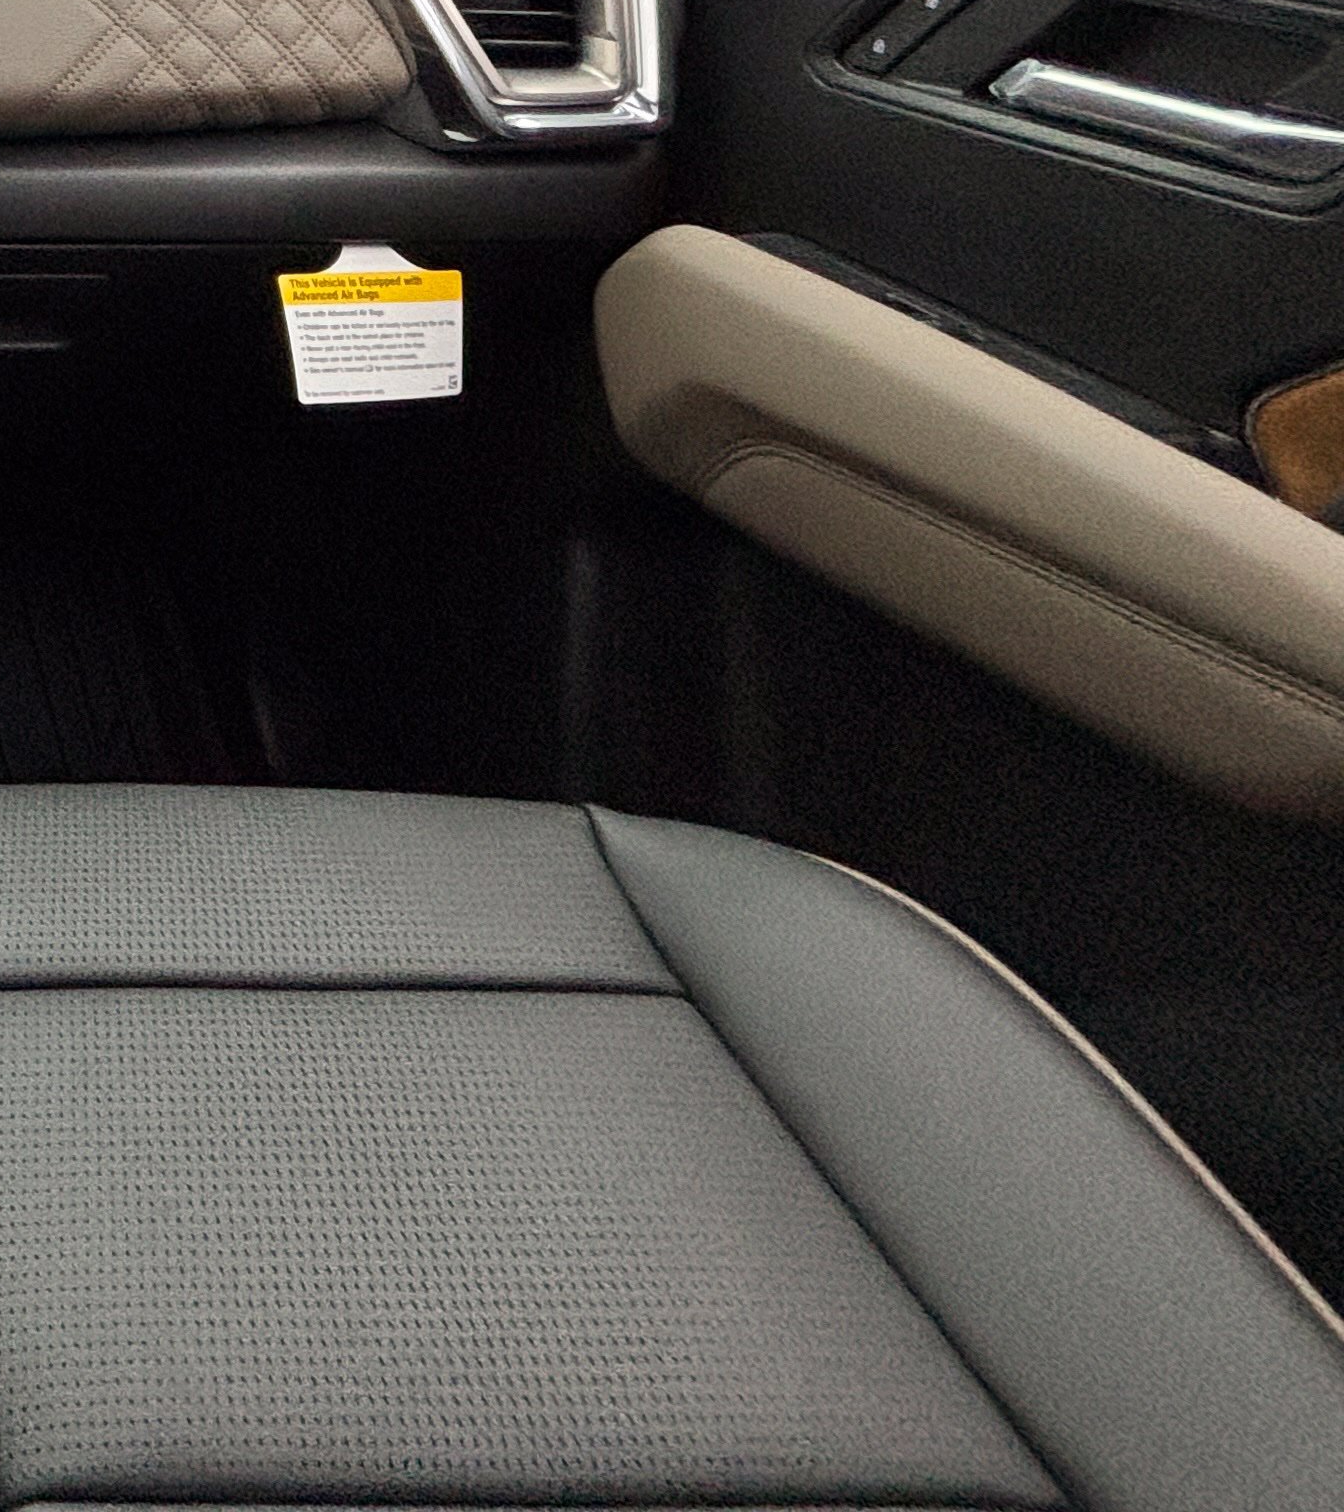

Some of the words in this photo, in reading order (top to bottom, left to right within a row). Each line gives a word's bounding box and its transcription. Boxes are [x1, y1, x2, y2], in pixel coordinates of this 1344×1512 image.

[289, 278, 310, 288] This
[313, 277, 346, 288] Vehicle
[359, 276, 401, 288] Equipped
[404, 277, 423, 286] with
[292, 289, 338, 301] Advanced
[341, 289, 353, 299] Air
[356, 289, 379, 301] Bags
